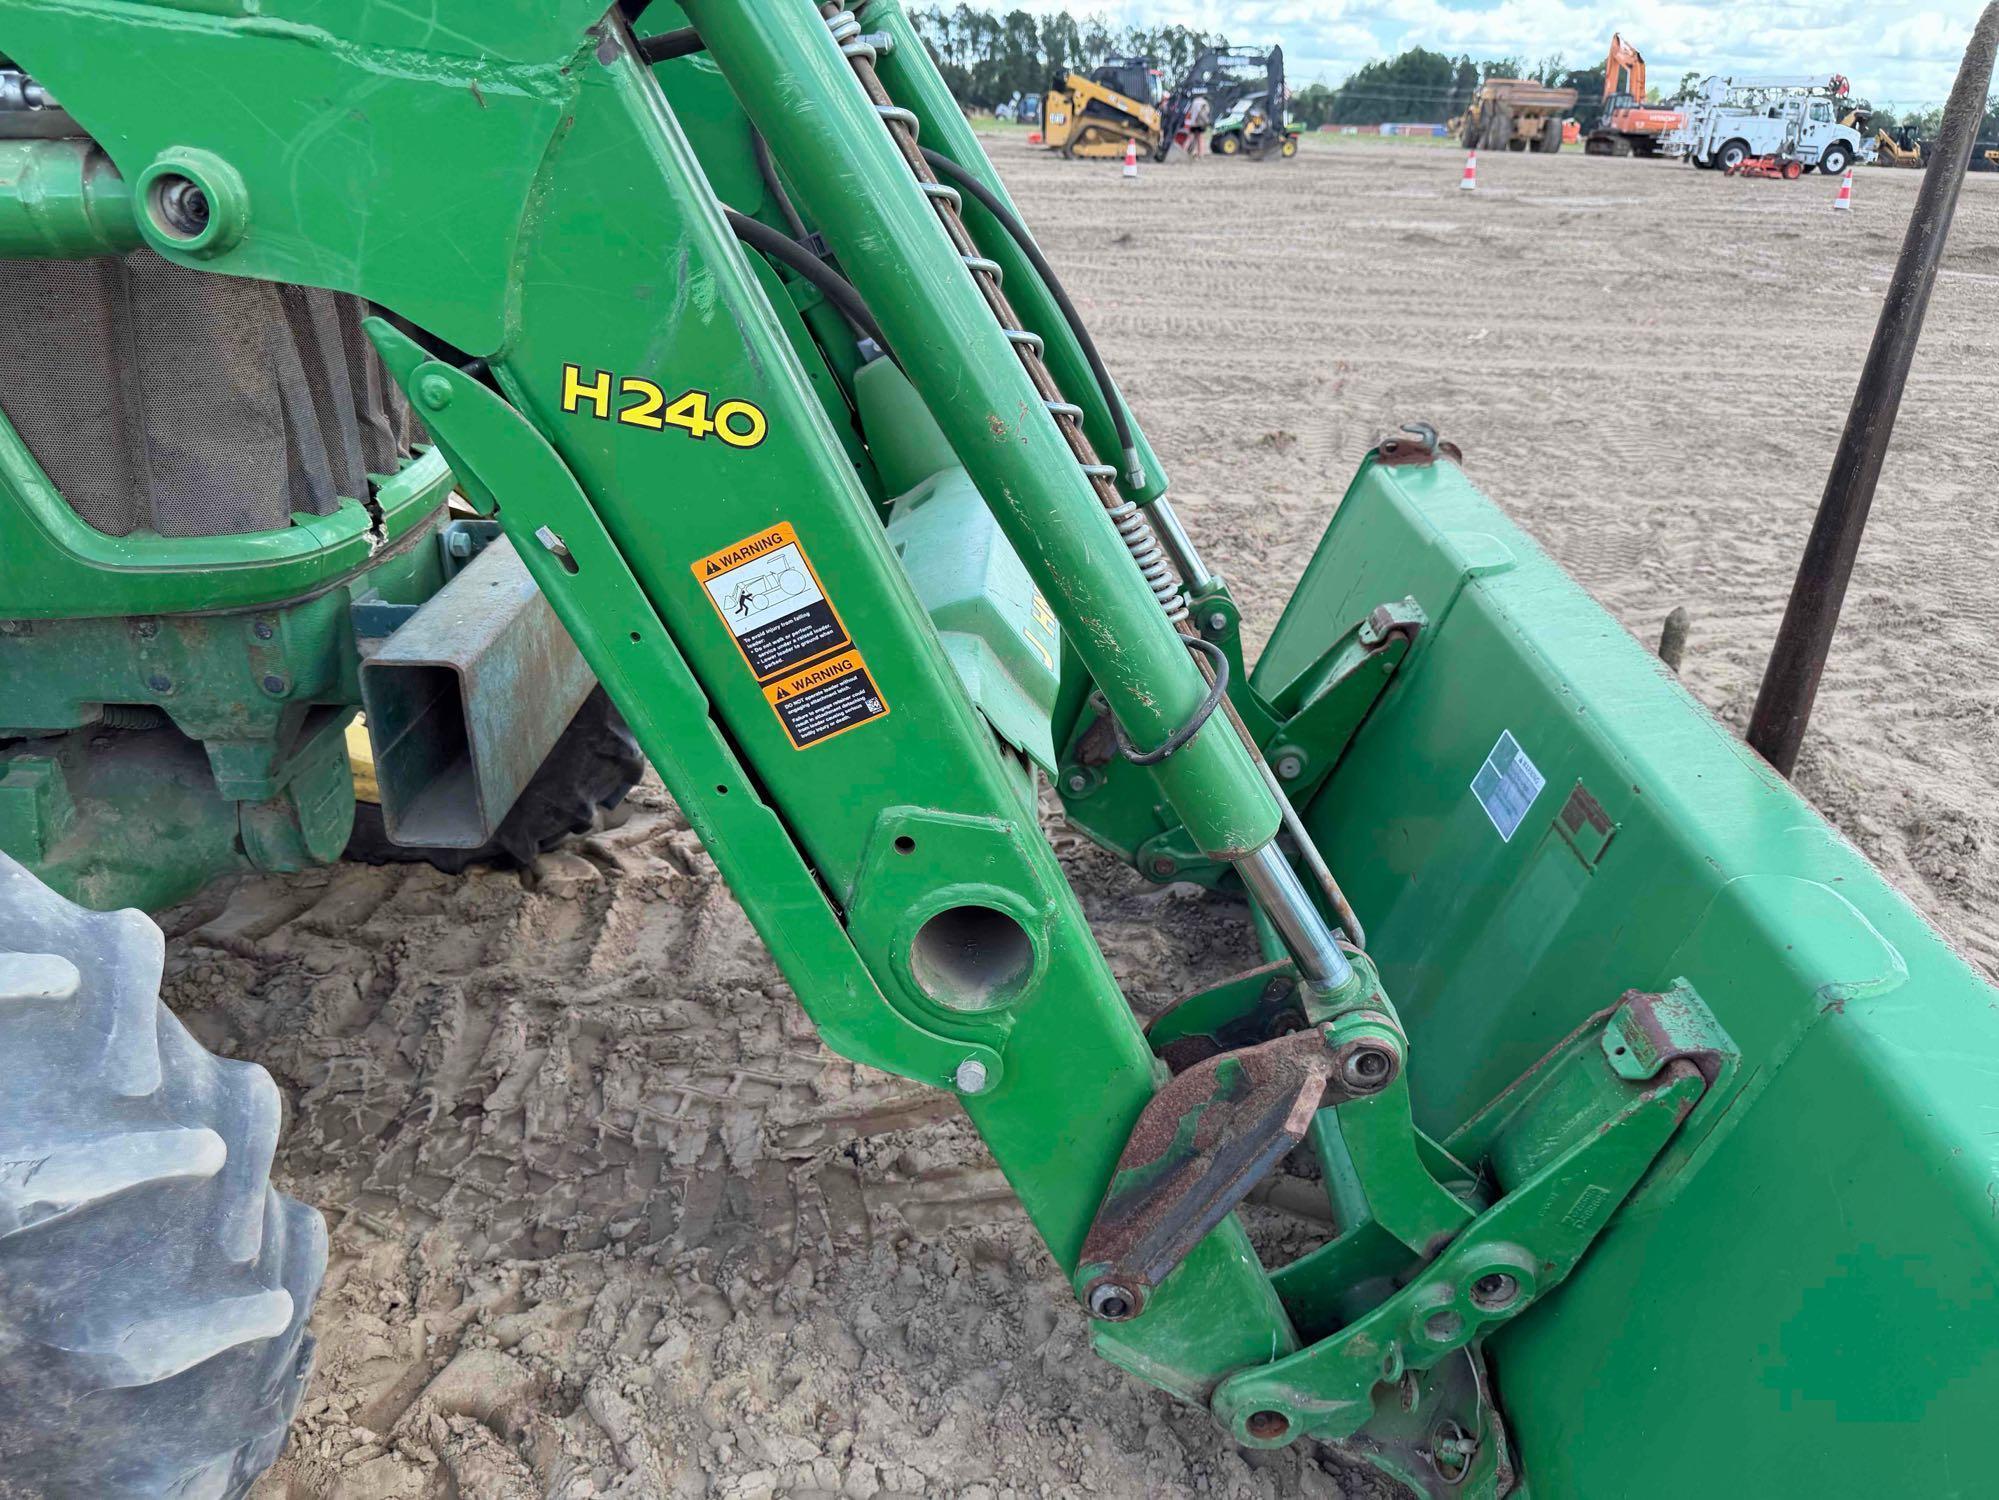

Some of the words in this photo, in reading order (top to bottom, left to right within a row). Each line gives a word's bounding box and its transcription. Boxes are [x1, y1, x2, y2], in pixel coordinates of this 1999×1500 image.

[559, 363, 768, 450] H240
[718, 532, 782, 566] WARNING
[791, 659, 852, 690] WARNING
